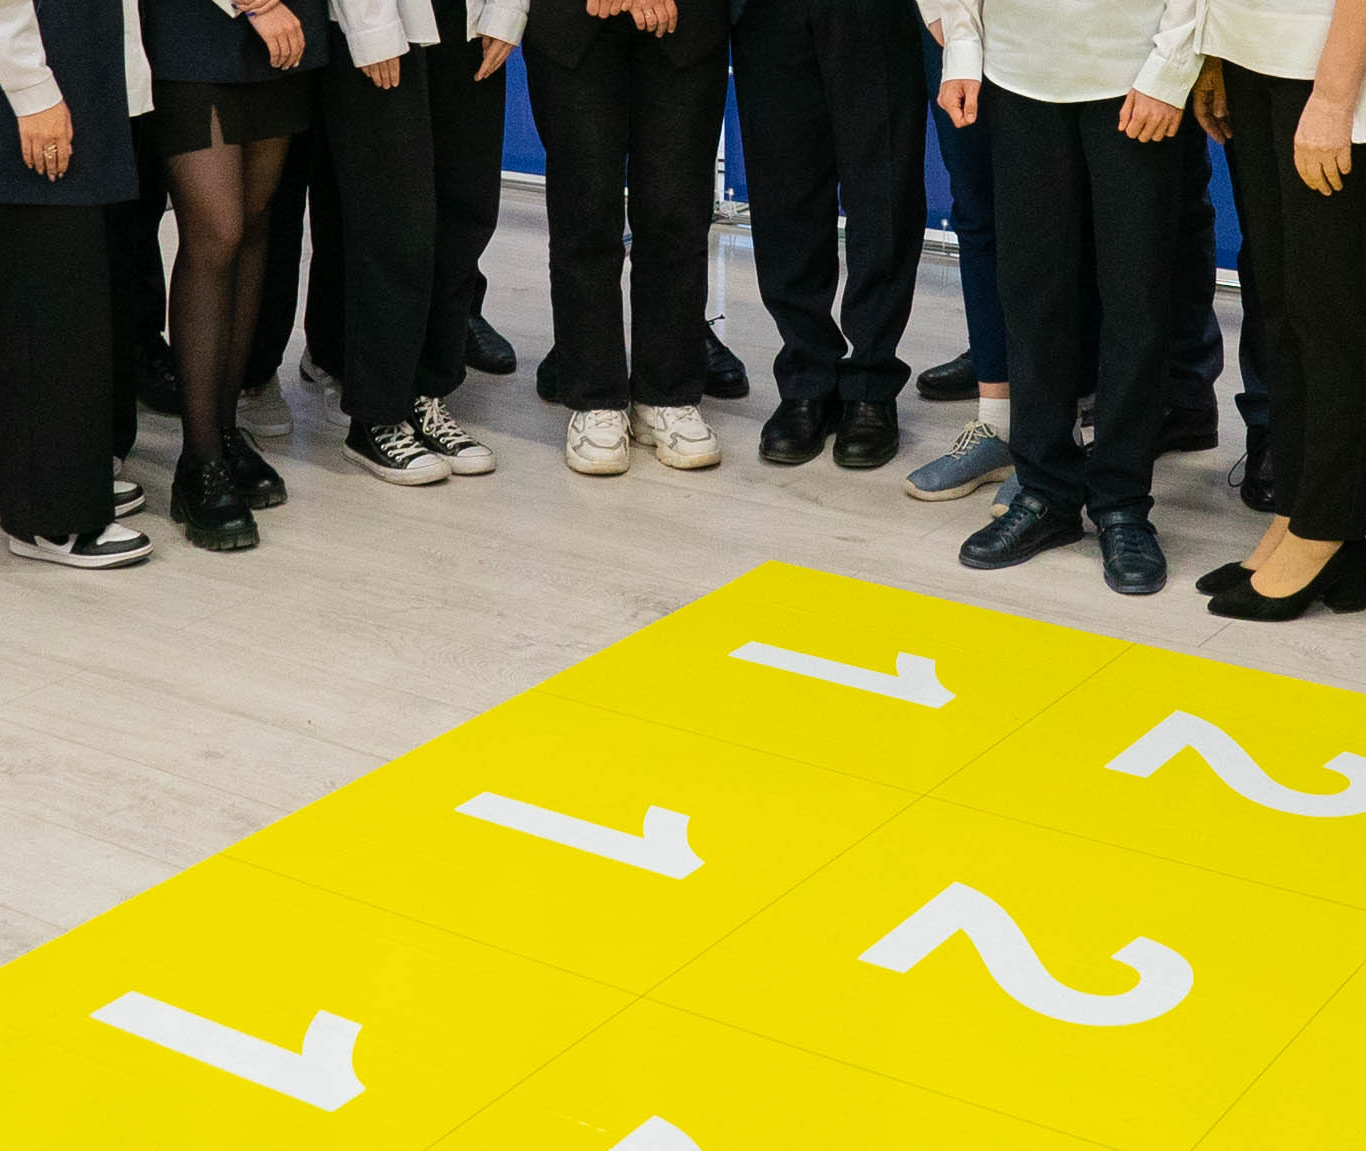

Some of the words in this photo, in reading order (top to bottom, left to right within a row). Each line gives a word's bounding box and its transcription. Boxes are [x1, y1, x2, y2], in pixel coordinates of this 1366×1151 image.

[729, 641, 956, 708] 1
[455, 792, 704, 879] 1
[857, 882, 1194, 1025] 2
[90, 991, 365, 1112] 1
